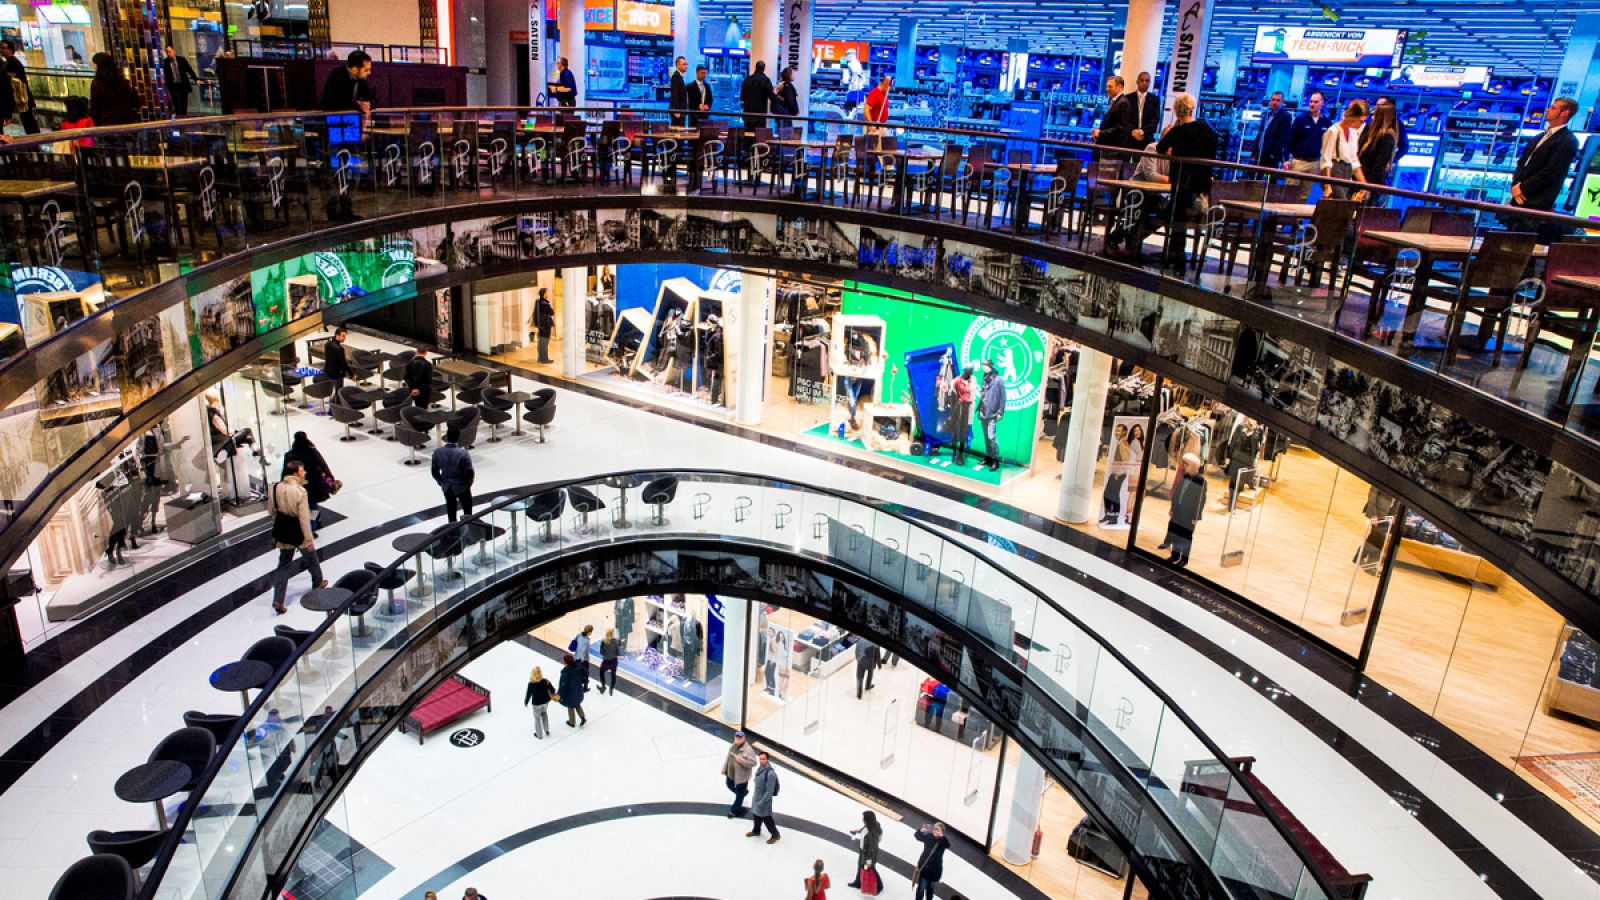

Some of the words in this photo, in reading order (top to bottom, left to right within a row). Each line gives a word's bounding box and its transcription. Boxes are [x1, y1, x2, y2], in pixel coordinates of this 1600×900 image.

[629, 10, 661, 28] INFO
[531, 20, 539, 61] SATURN
[788, 22, 801, 71] SATURN
[1292, 40, 1368, 52] TECH-NICK
[1172, 33, 1194, 92] SATURN
[978, 318, 1028, 341] BERLIN
